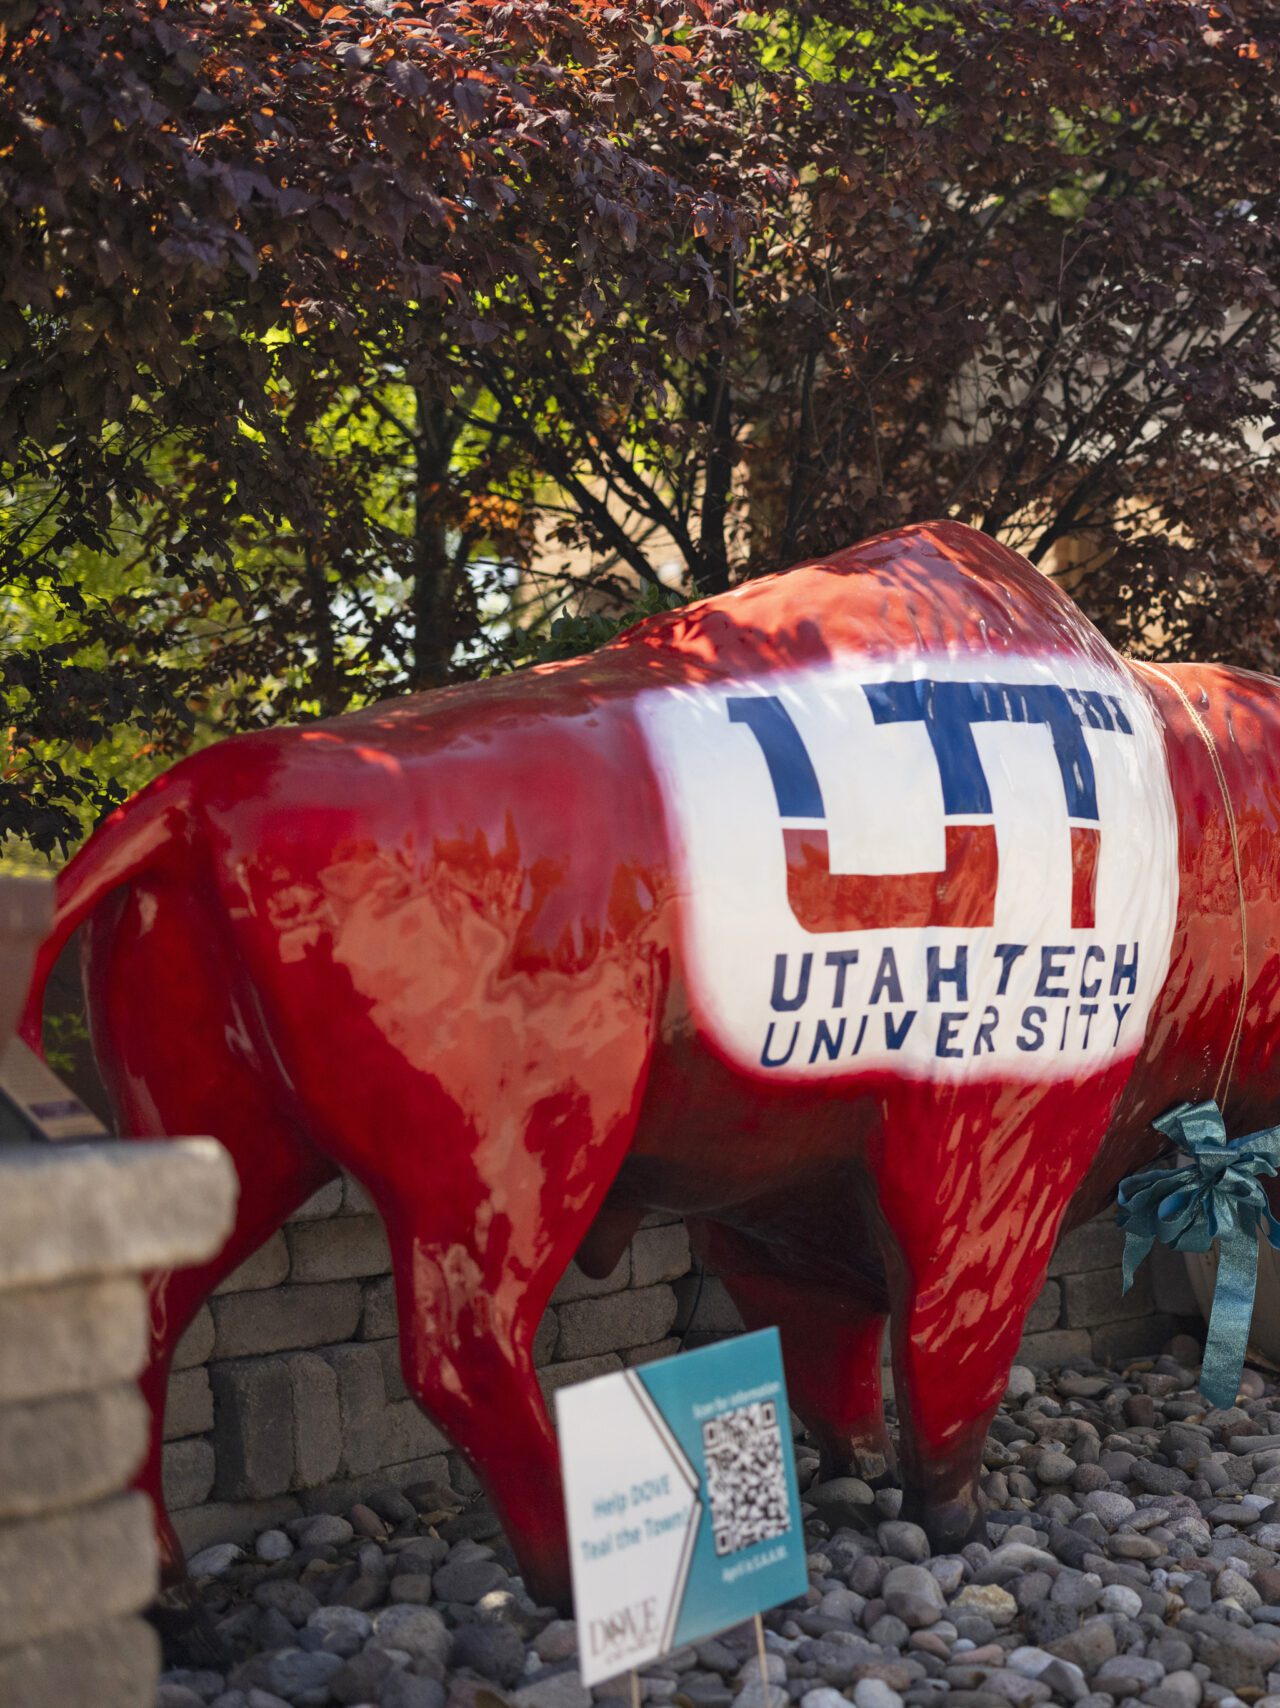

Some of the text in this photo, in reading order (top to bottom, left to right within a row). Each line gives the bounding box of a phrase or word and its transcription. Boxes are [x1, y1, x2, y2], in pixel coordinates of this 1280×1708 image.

[769, 941, 1140, 1012] UTAH TECH
[759, 1003, 1132, 1068] UNIVERSITY
[592, 1491, 627, 1518] Help
